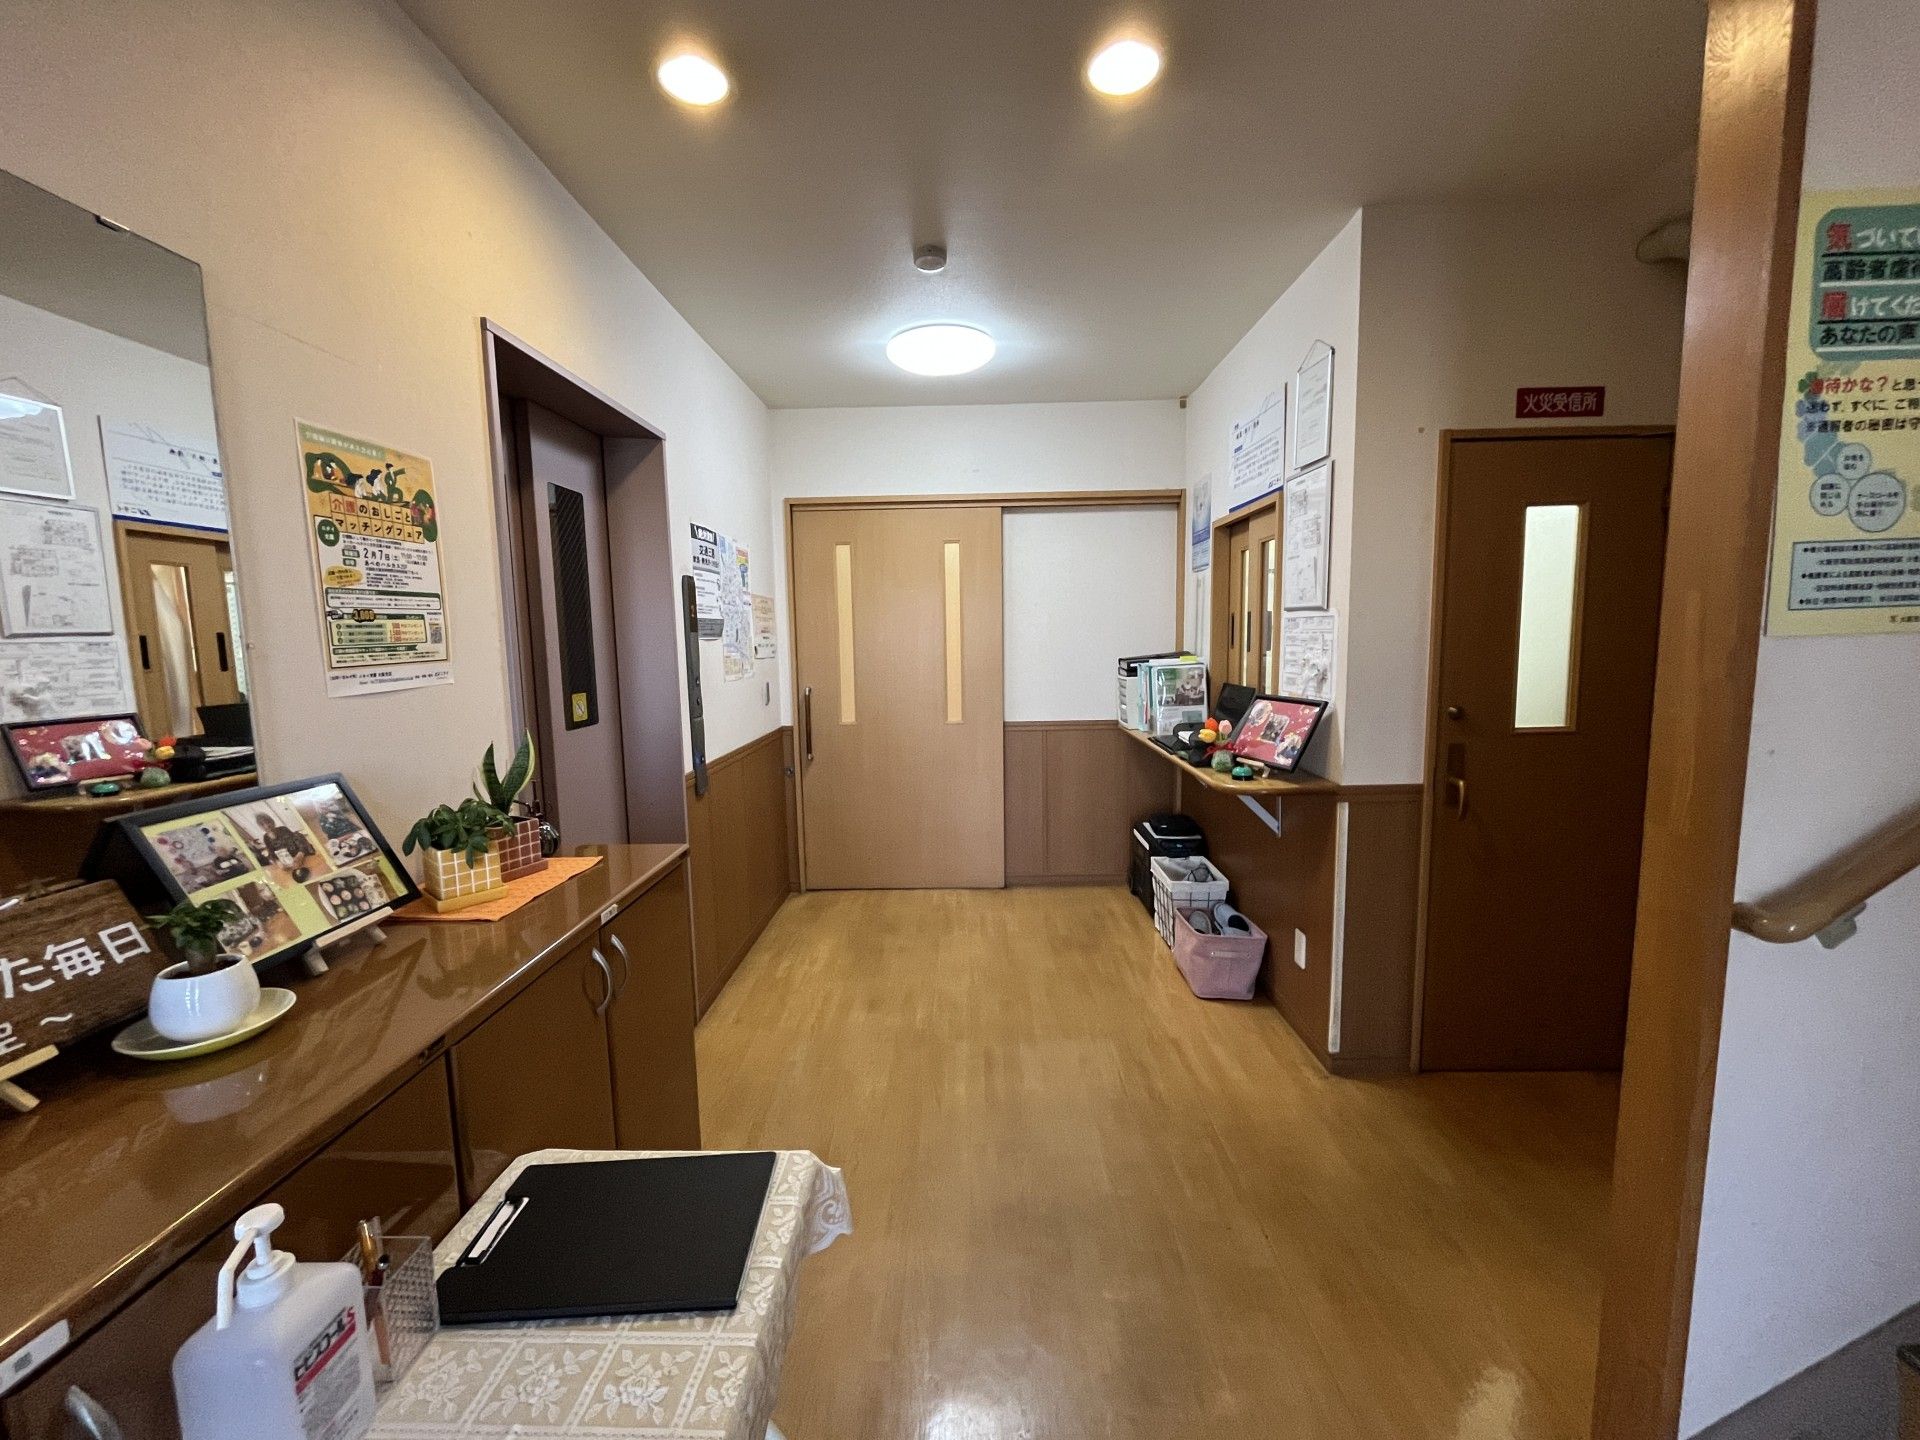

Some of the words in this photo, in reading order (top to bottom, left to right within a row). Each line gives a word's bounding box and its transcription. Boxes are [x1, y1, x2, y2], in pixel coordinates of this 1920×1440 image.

[335, 518, 423, 540] マッチングフェア
